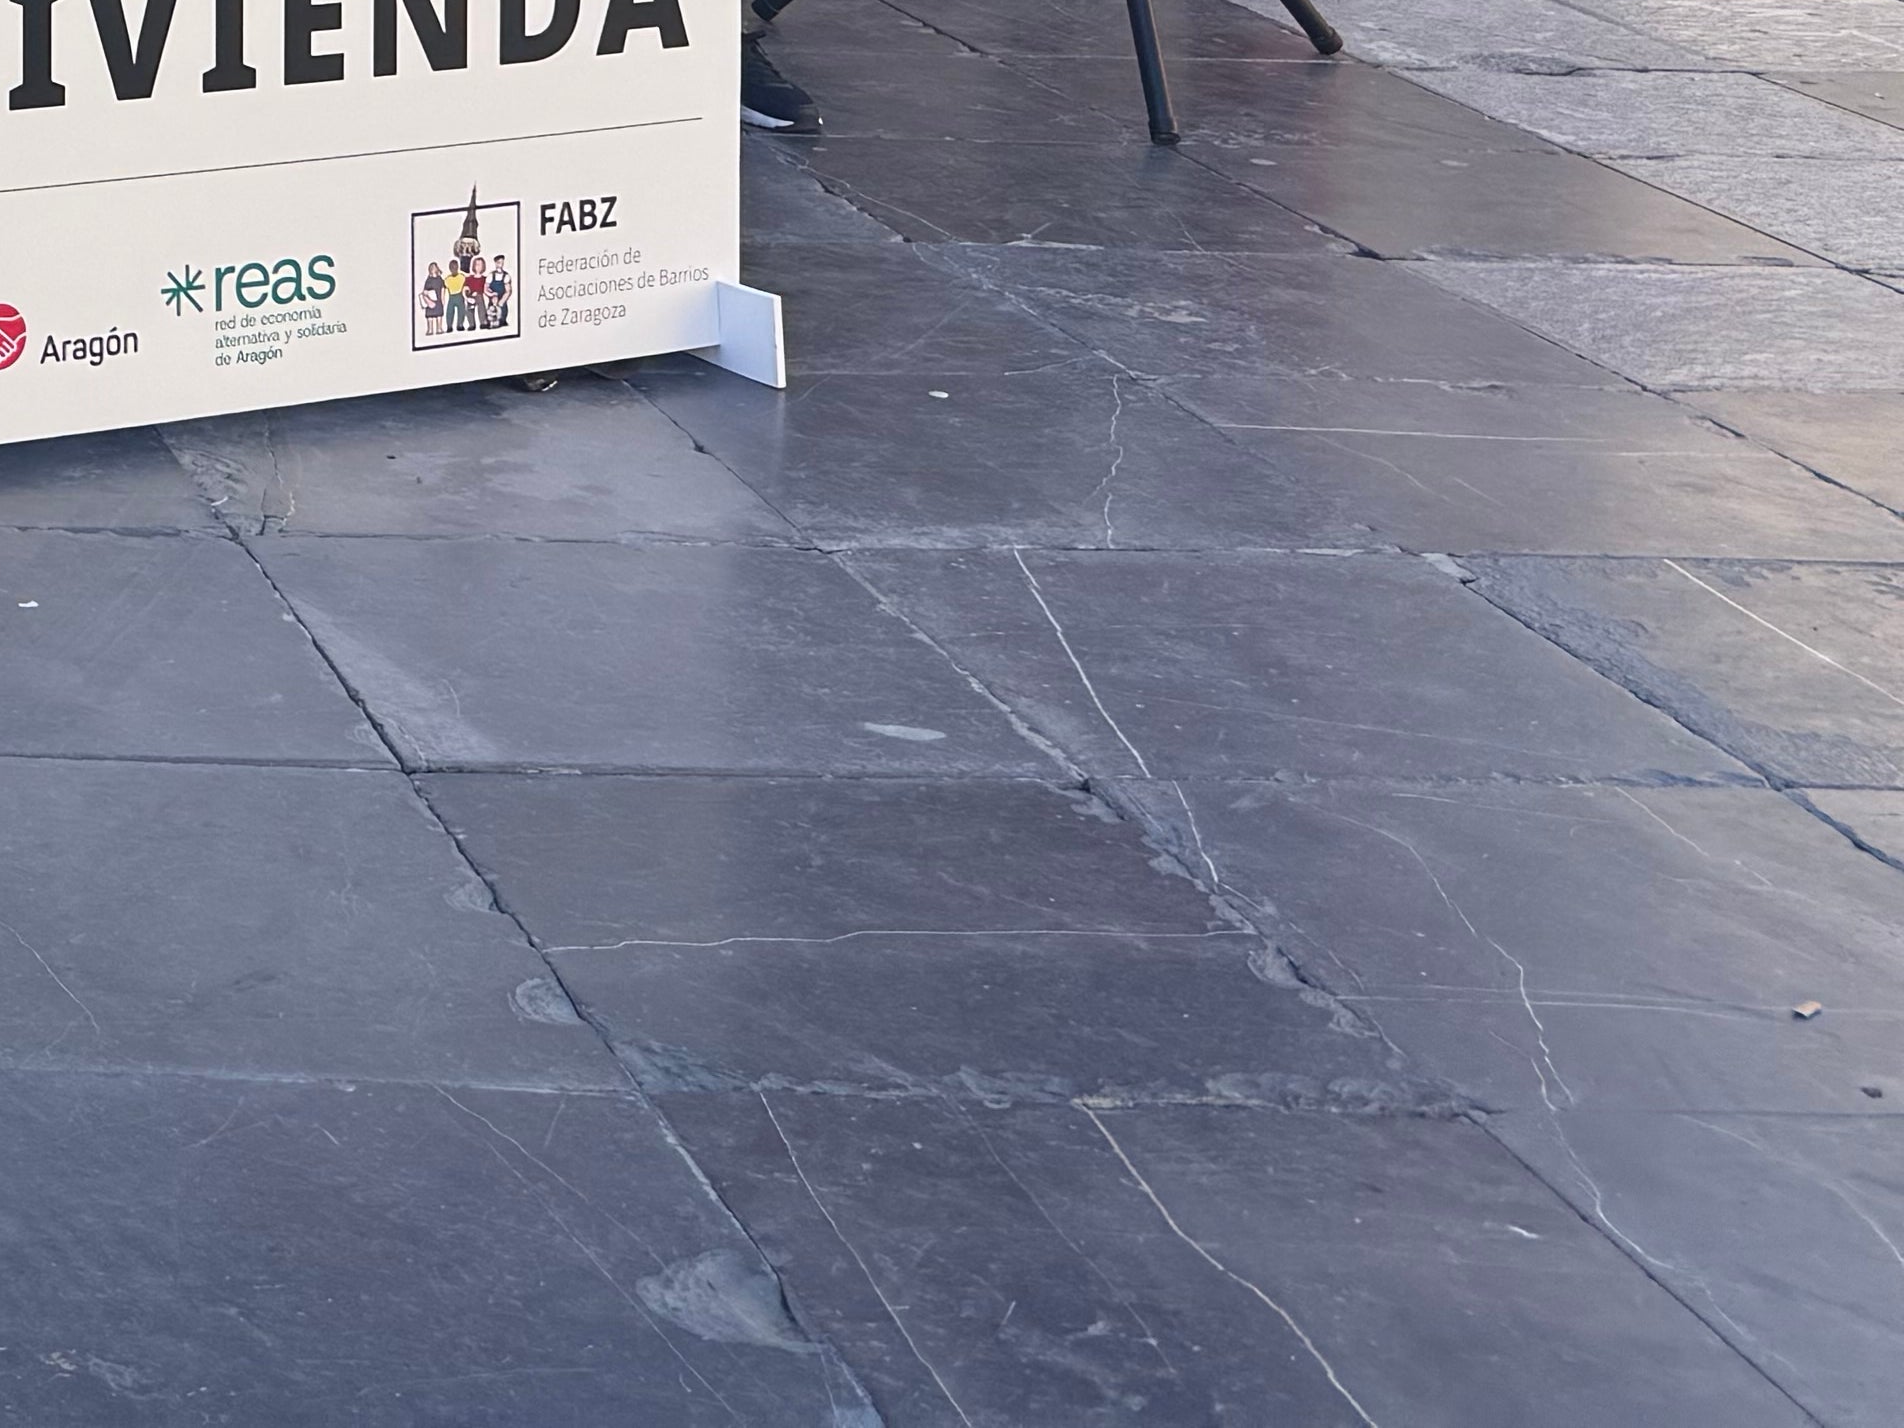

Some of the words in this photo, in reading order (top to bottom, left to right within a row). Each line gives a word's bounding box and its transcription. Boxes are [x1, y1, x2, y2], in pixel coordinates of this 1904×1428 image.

[540, 196, 617, 235] FABZ
[538, 250, 619, 275] Federación
[624, 248, 641, 264] de
[215, 255, 336, 311] reas
[538, 278, 633, 301] Asociaciones
[637, 269, 655, 289] de
[659, 266, 709, 286] Barrios
[215, 315, 236, 330] red
[240, 314, 256, 328] de
[261, 306, 322, 326] economía
[538, 311, 556, 328] de
[561, 303, 626, 326] Zaragoza
[40, 327, 138, 366] Aragón
[215, 331, 280, 349] alternativa
[285, 330, 292, 344] y
[215, 353, 231, 366] de
[237, 346, 283, 365] Aragón
